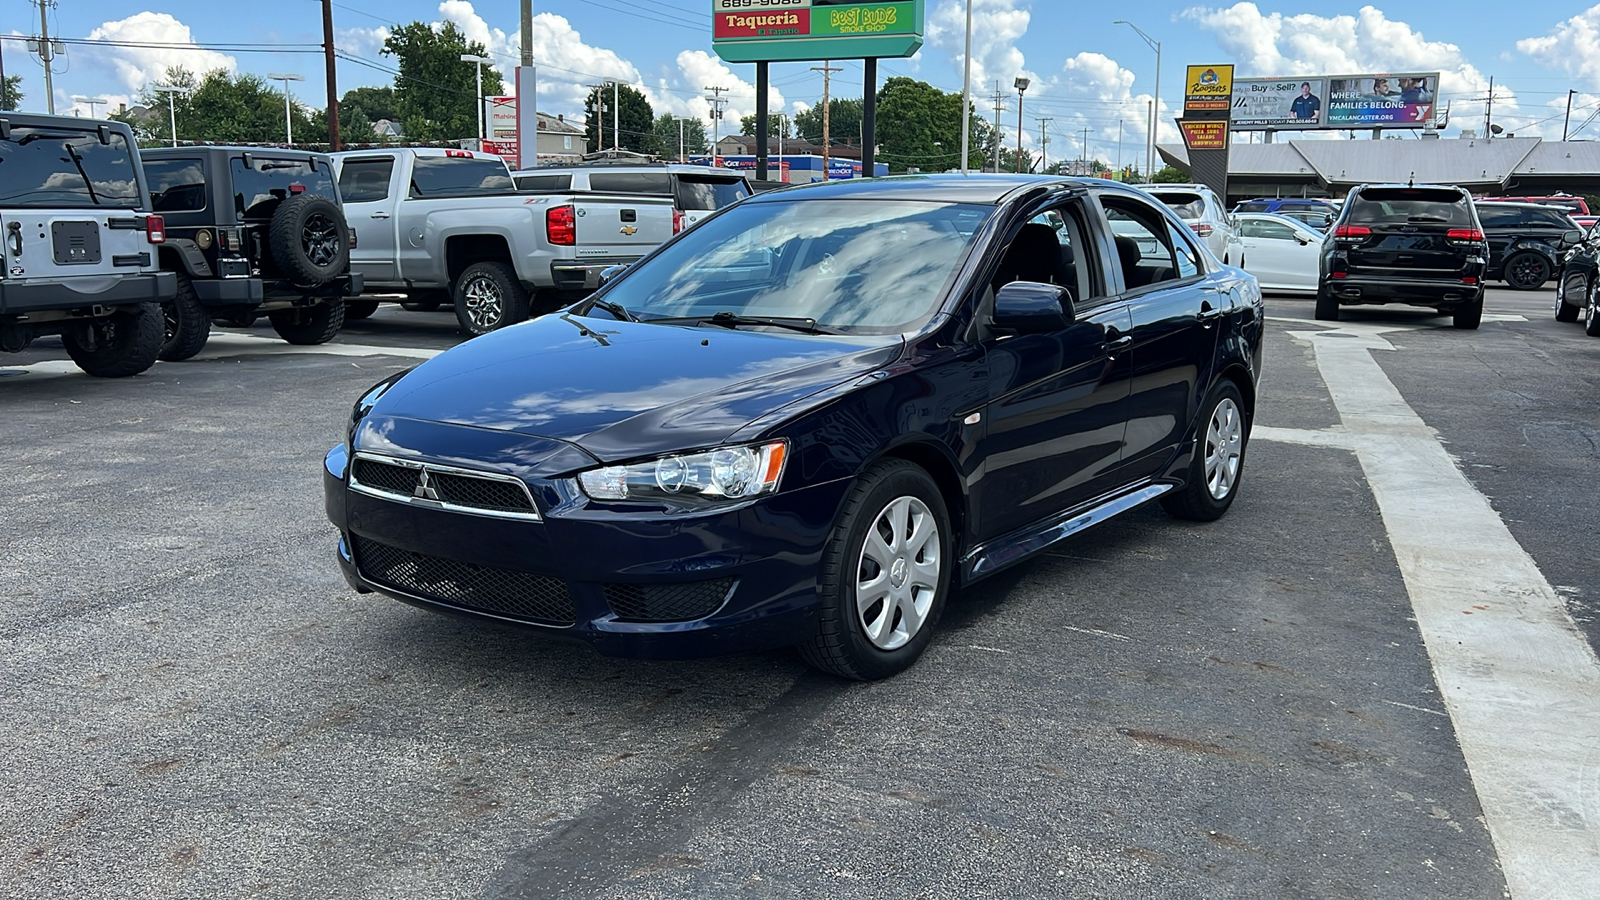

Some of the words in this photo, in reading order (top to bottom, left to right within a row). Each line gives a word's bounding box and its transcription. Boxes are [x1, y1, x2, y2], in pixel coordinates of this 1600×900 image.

[726, 11, 799, 29] Taquería
[839, 25, 865, 33] SMOKE
[866, 24, 886, 32] SHOP
[1191, 83, 1227, 94] Roosters
[1252, 84, 1268, 93] Buy
[1276, 83, 1296, 91] Sell?
[1331, 91, 1361, 99] WHERE
[1330, 101, 1368, 109] FAMILIES
[1370, 101, 1407, 109] BELONG.
